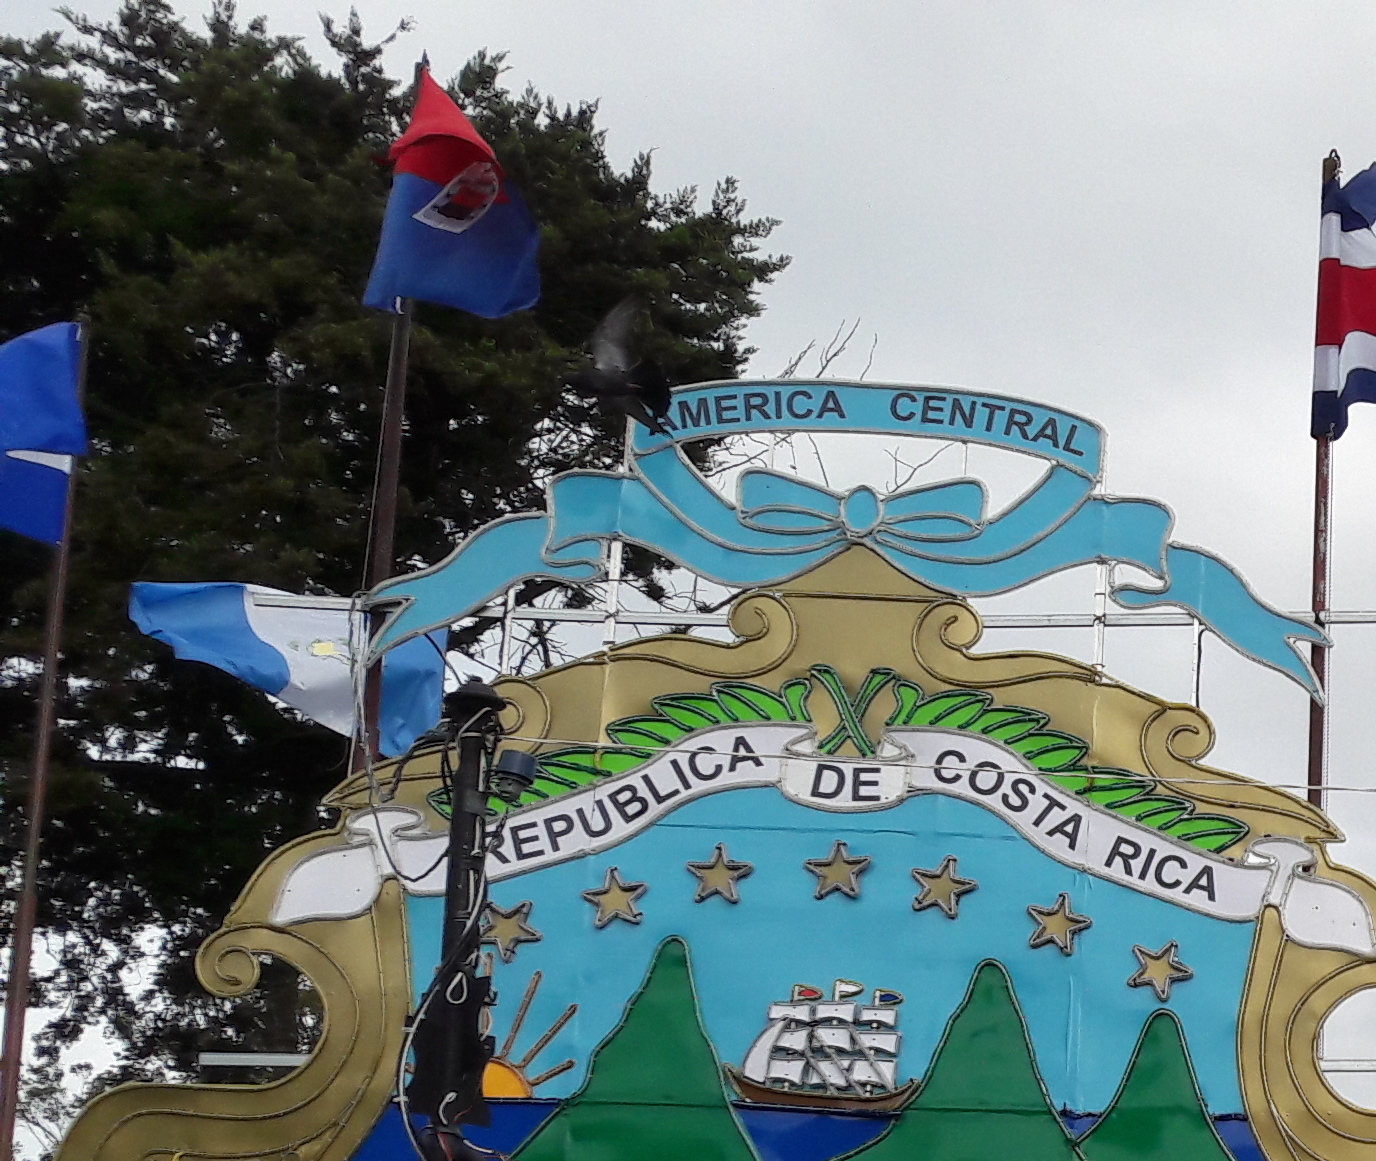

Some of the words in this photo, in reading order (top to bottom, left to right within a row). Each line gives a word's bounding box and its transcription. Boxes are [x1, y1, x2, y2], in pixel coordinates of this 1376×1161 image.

[889, 392, 1084, 457] CENTRAL
[484, 735, 764, 864] REPUBLICA
[811, 763, 882, 801] DE
[933, 750, 1083, 851] COSTA
[1104, 836, 1217, 902] RICA
